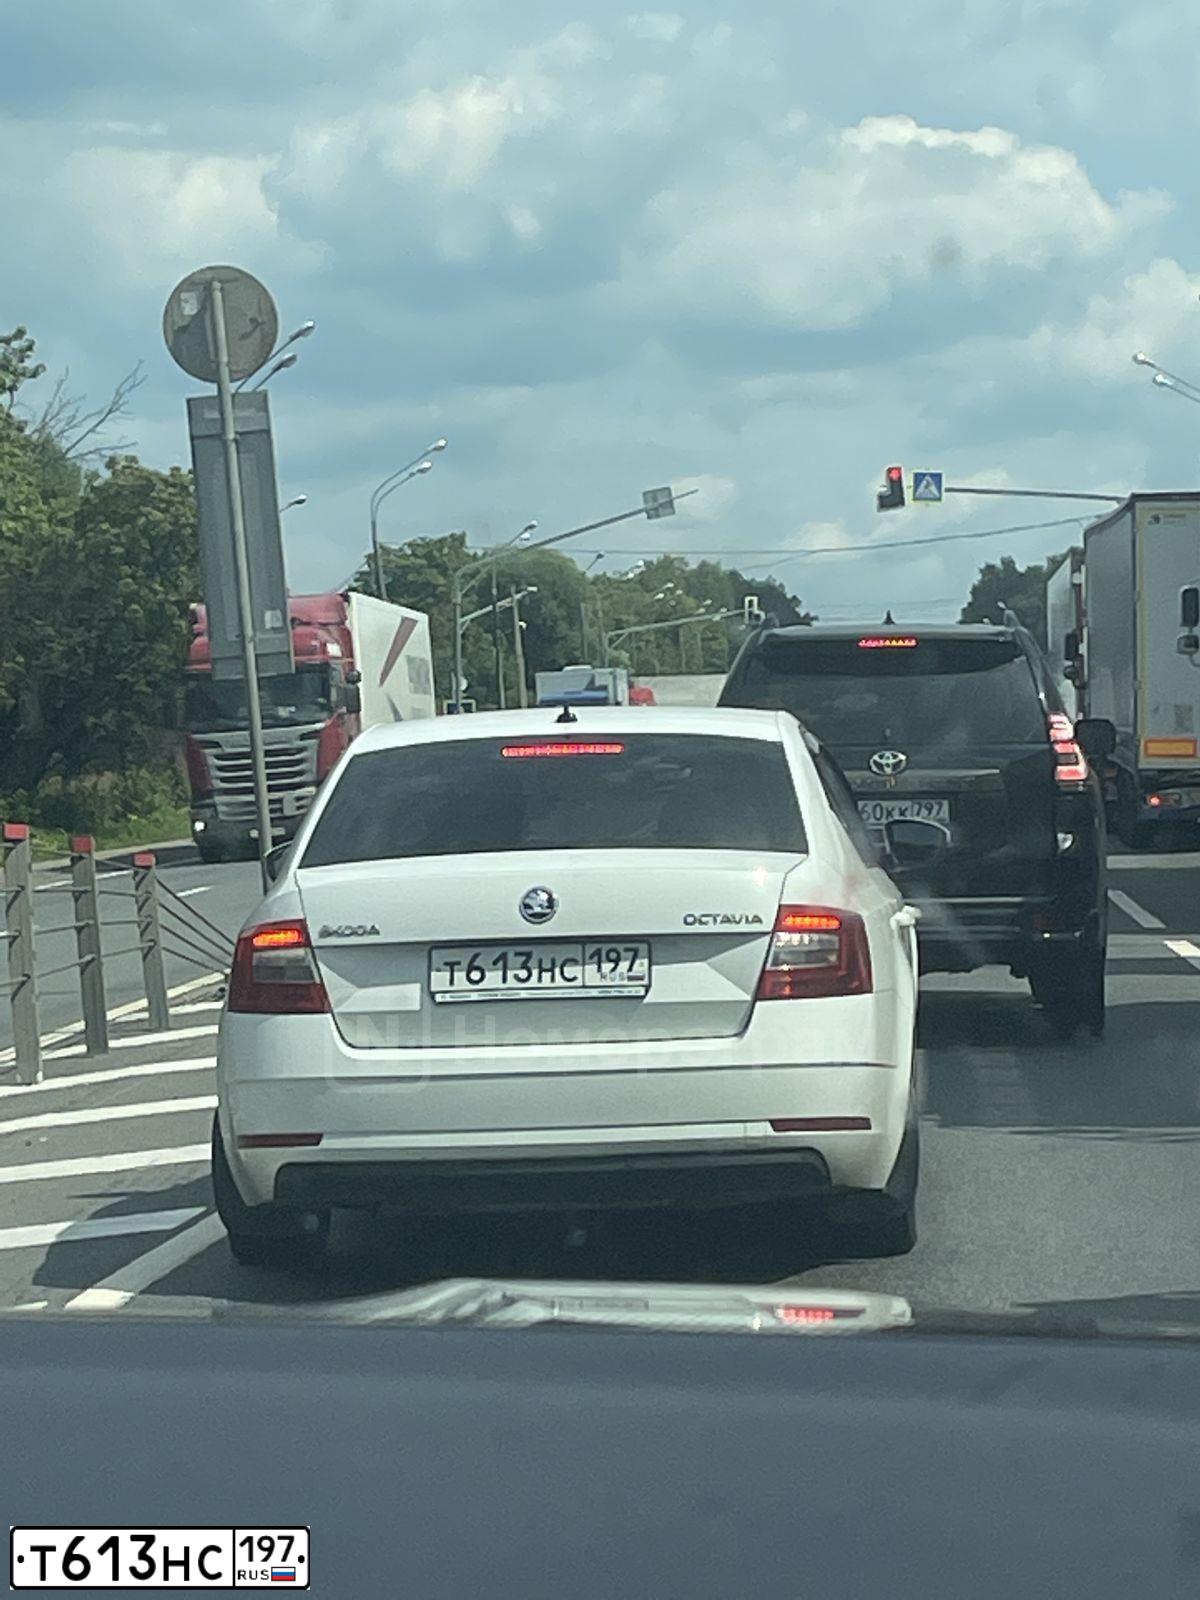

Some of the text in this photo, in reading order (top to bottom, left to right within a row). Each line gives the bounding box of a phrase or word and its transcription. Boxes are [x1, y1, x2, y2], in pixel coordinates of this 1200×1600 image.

[861, 802, 907, 821] 60КК
[683, 913, 764, 926] OCTAVIA
[443, 947, 640, 986] Т613НС 197
